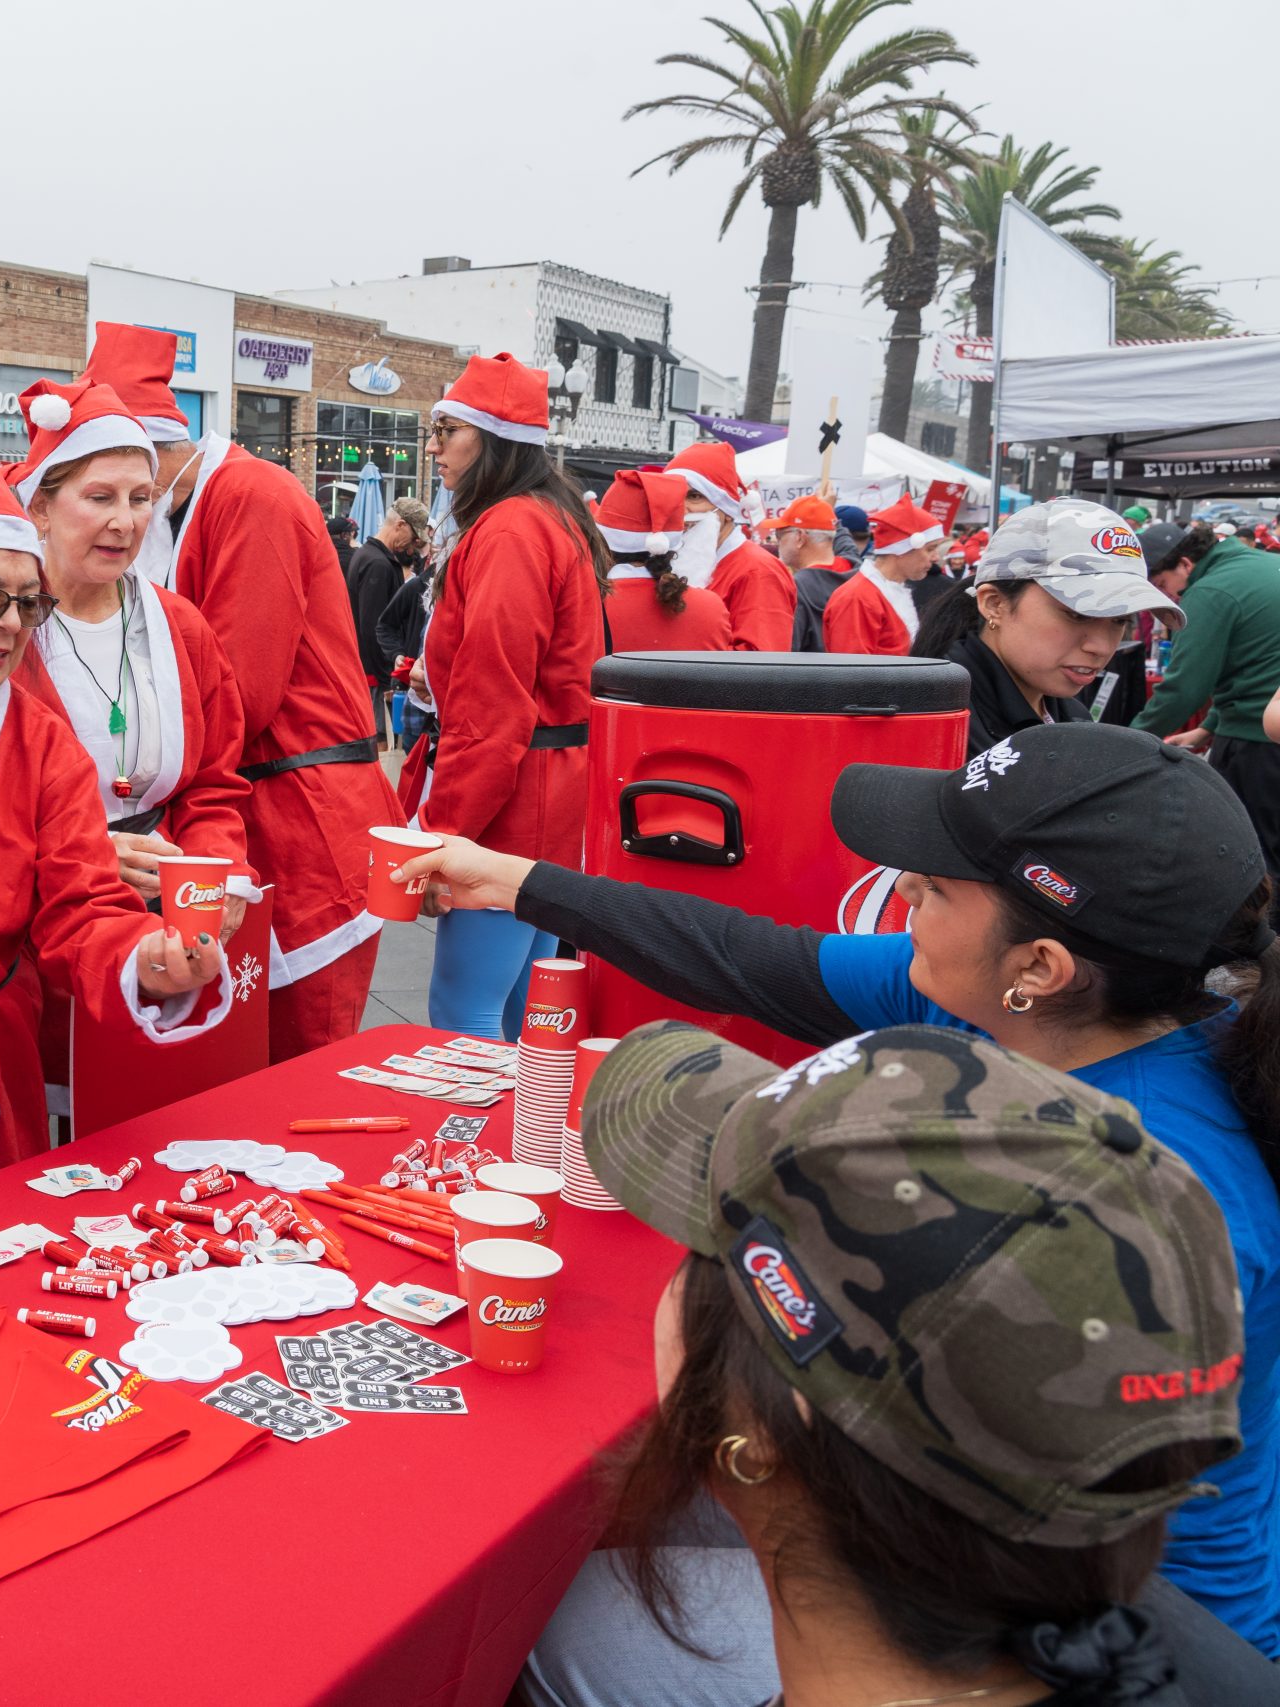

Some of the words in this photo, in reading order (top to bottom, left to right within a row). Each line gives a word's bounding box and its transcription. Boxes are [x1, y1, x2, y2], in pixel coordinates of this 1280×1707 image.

[239, 338, 312, 365] OAKBERRY
[711, 420, 747, 438] kinecta
[1143, 458, 1271, 478] EVOLUTION
[1023, 864, 1078, 900] Cane's
[526, 1007, 577, 1035] Cane's
[58, 1281, 74, 1291] LIP
[75, 1282, 105, 1295] SAUCE
[743, 1245, 817, 1329] Cane's
[478, 1294, 548, 1326] Cane's
[337, 1333, 363, 1350] ONE
[369, 1331, 396, 1348] ONE
[385, 1324, 413, 1343] ONE
[287, 1342, 299, 1360] ONE
[312, 1342, 326, 1360] ONE
[353, 1359, 380, 1375] ONE
[369, 1368, 398, 1382] ONE
[256, 1378, 284, 1397] ONE
[357, 1383, 387, 1393] ONE
[1121, 1371, 1185, 1403] ONE
[229, 1389, 260, 1407] ONE
[359, 1397, 390, 1407] ONE
[67, 1394, 135, 1431] ne's
[215, 1400, 243, 1417] ONE
